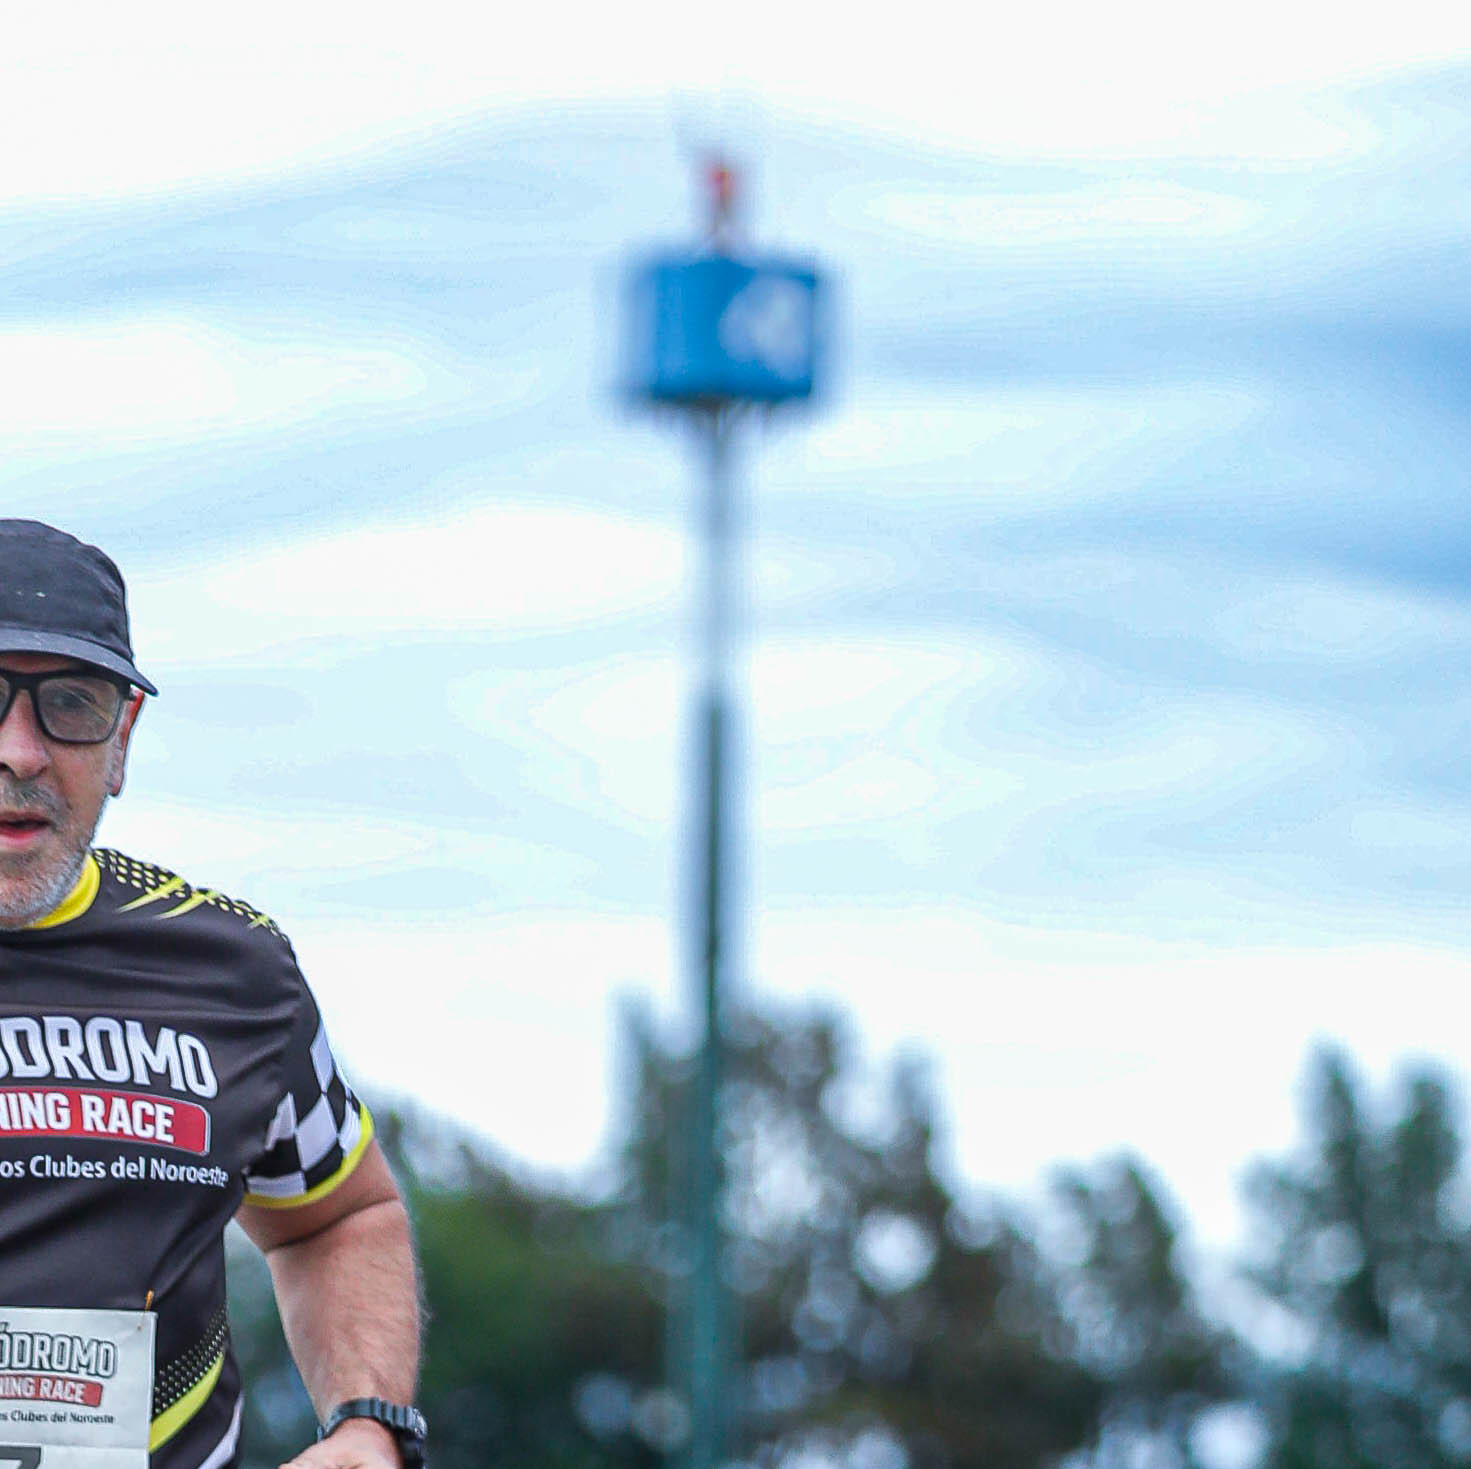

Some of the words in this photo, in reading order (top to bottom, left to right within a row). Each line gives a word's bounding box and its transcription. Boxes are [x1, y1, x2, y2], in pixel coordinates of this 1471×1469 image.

[80, 1093, 175, 1143] RACE
[29, 1156, 106, 1179] Clubes
[111, 1155, 146, 1179] del
[38, 1379, 86, 1403] RACE
